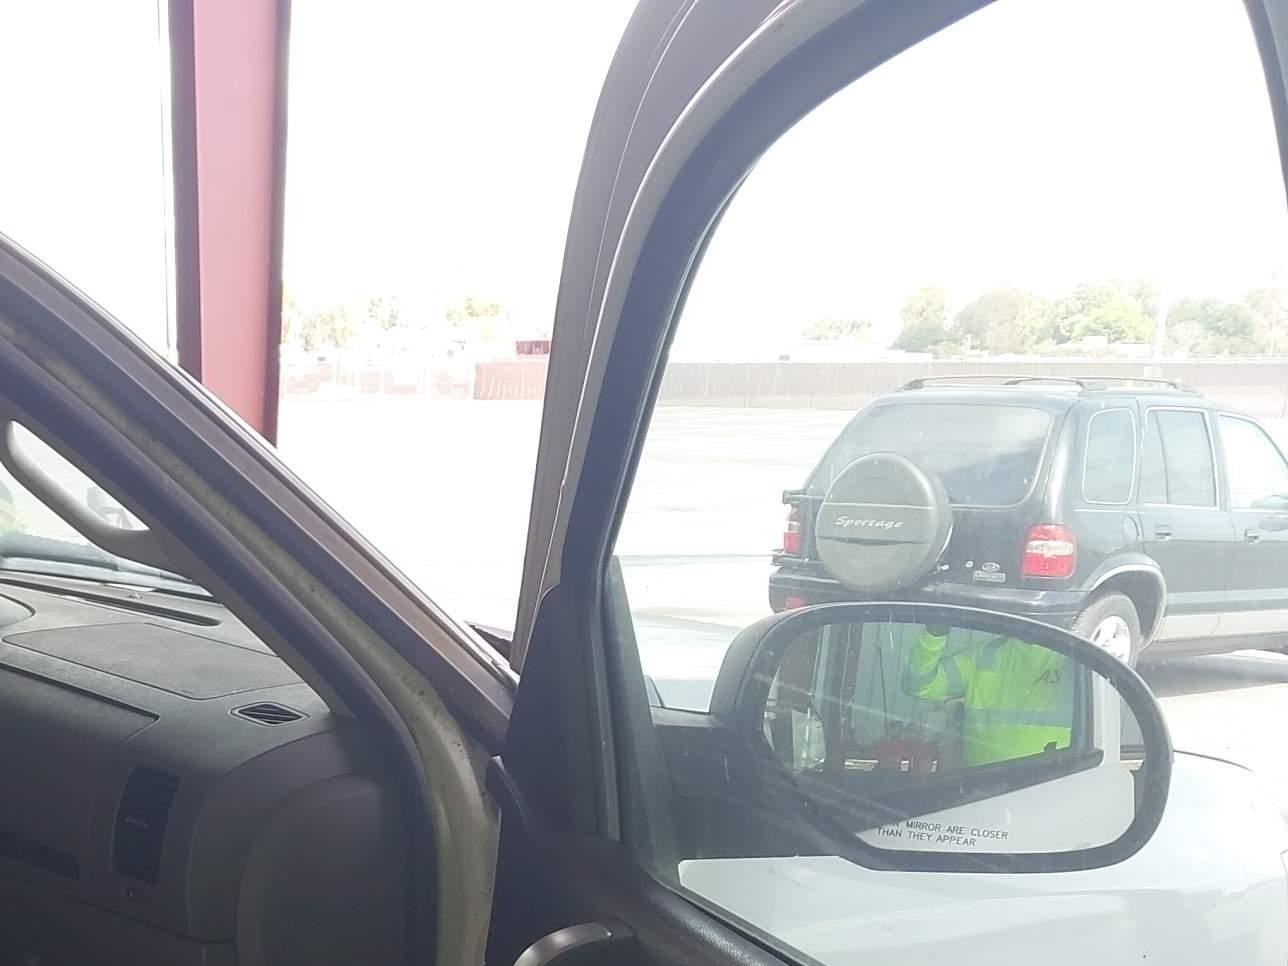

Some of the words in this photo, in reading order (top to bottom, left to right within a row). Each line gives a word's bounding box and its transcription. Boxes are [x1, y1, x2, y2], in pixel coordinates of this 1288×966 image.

[835, 515, 904, 529] Sportage
[878, 827, 902, 838] THAN
[908, 831, 933, 841] THEY
[936, 835, 976, 847] APPEAR
[906, 821, 941, 832] MIRROR
[946, 825, 964, 835] ARE
[970, 828, 1008, 840] CLOSER
